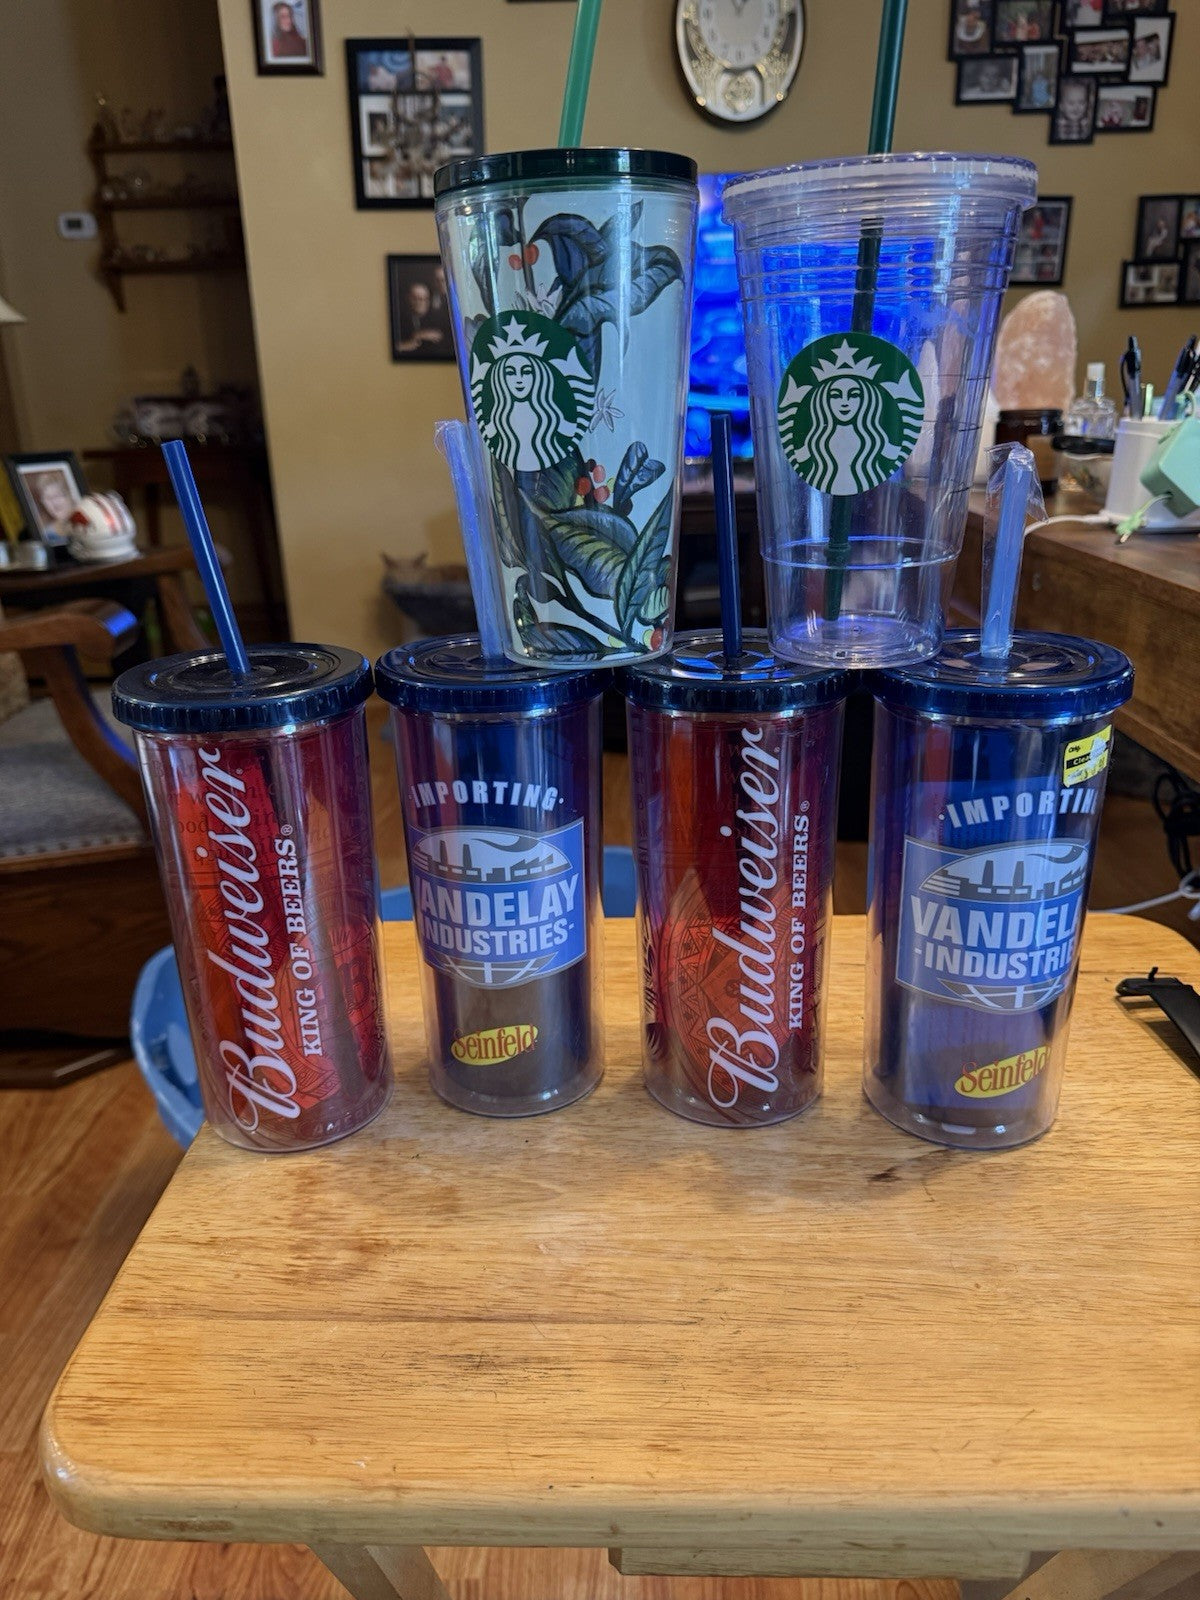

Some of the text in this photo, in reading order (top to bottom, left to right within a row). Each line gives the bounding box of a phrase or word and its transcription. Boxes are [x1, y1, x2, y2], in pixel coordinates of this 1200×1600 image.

[196, 747, 301, 1132] Budweiser
[706, 727, 780, 1108] Budweiser
[790, 917, 806, 954] OF
[289, 942, 313, 981] OF
[295, 986, 323, 1057] KING
[789, 962, 805, 1030] KING
[453, 1023, 535, 1060] Seinfeld
[961, 1044, 1051, 1093] Seinfeld
